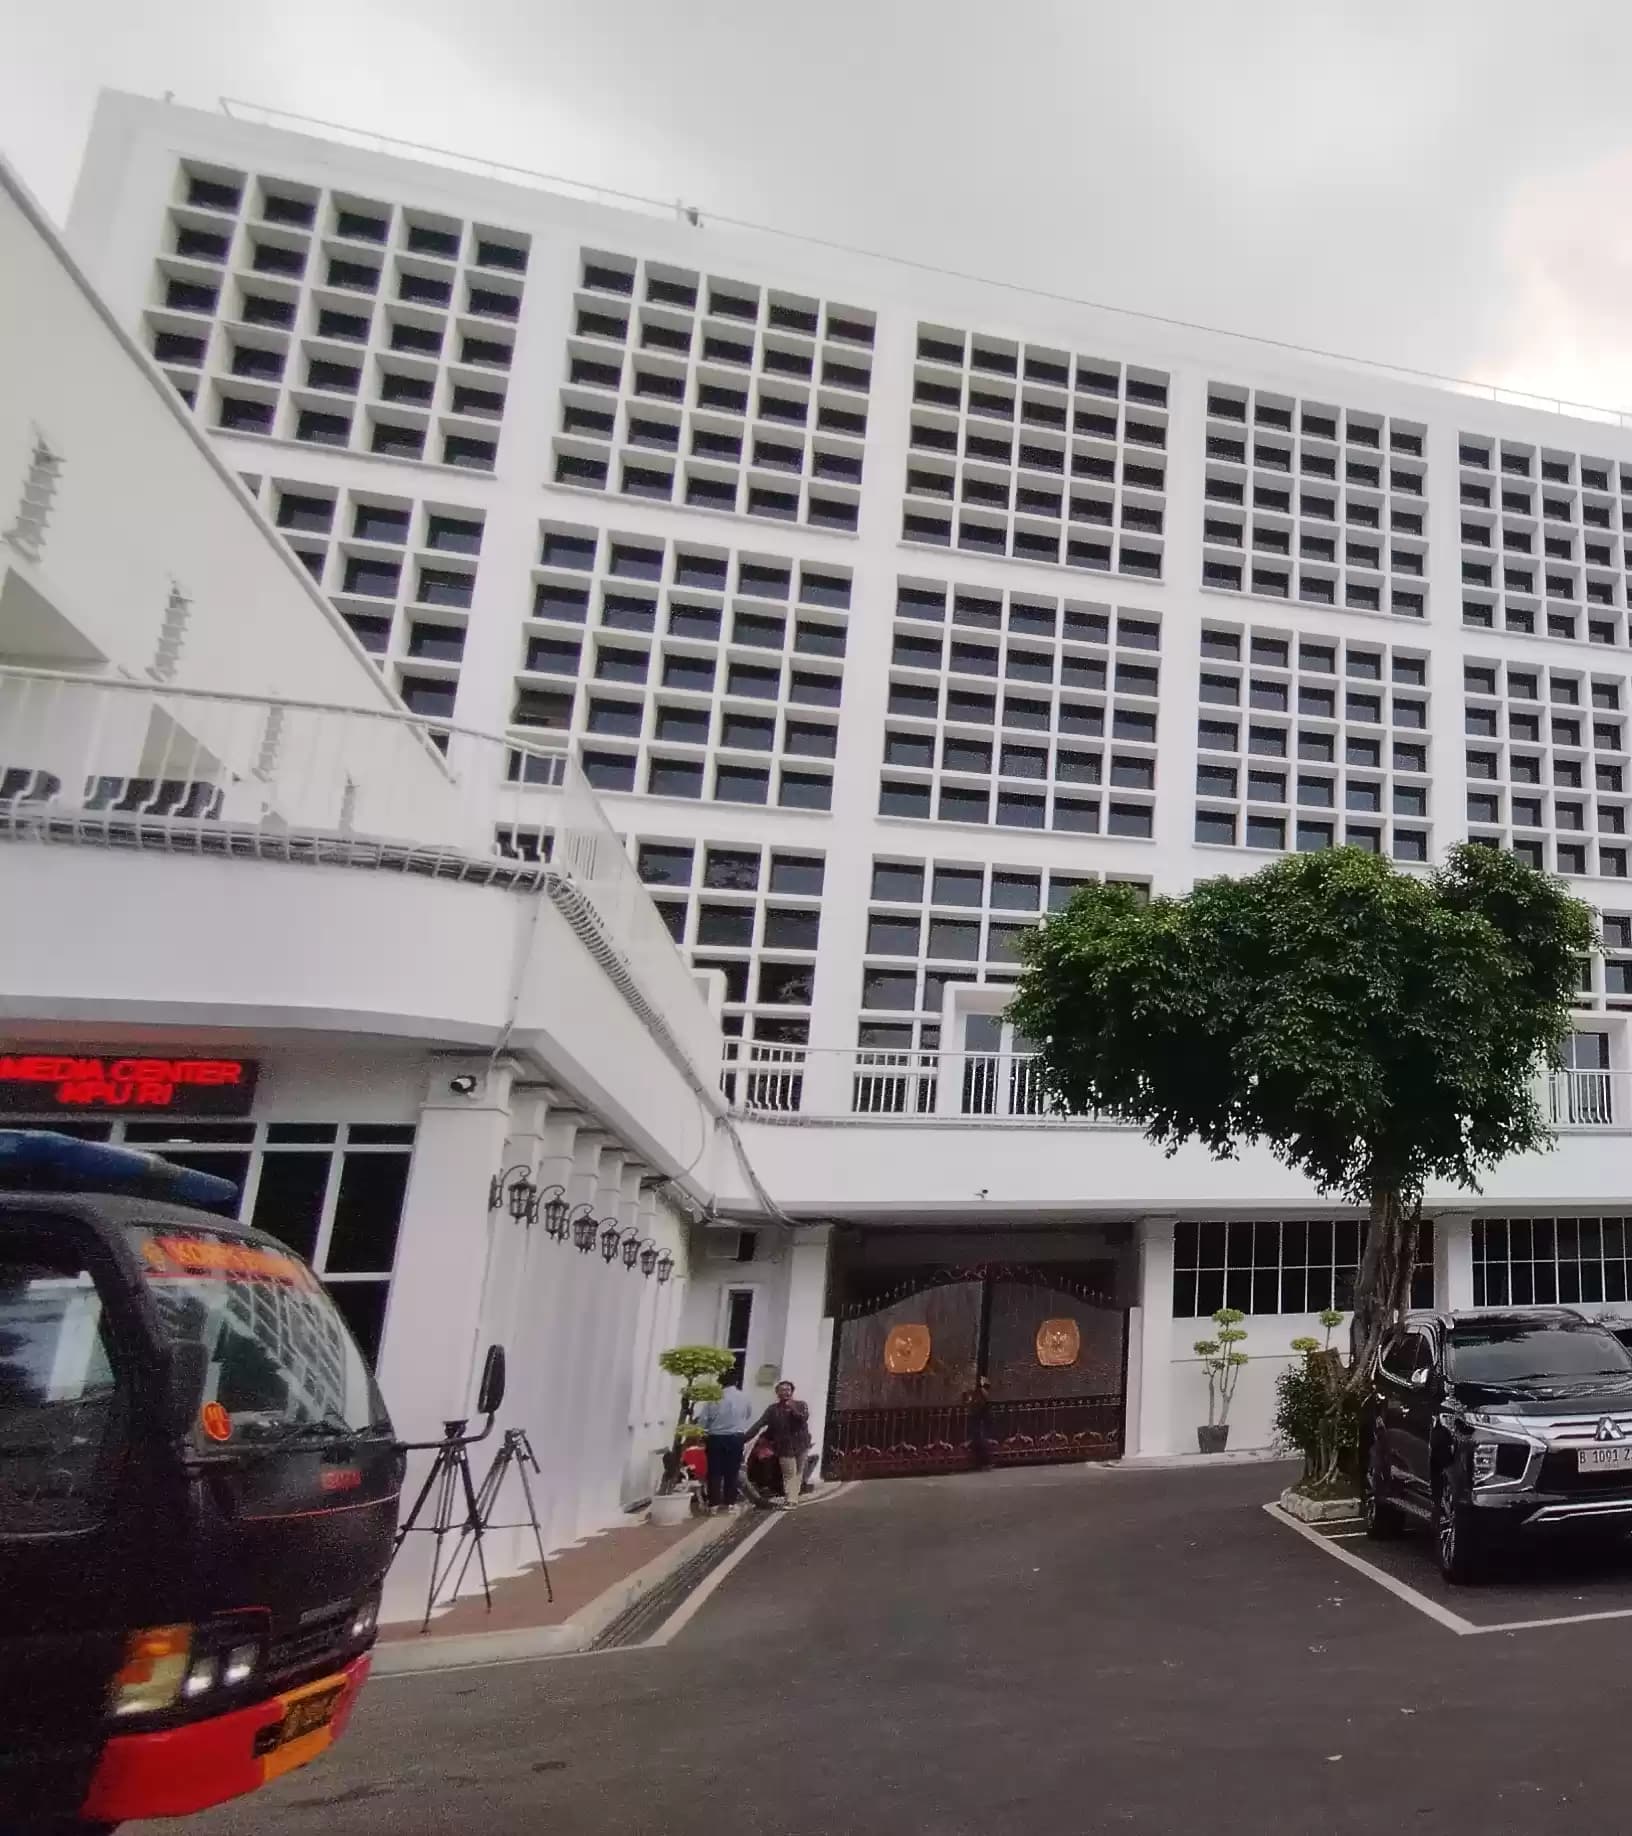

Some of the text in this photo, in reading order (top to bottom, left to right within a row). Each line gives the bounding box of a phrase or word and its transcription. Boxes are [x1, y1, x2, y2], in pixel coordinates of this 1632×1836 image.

[0, 1055, 242, 1084] MEDIA CENTER
[1579, 1451, 1586, 1464] B
[1592, 1448, 1619, 1464] 1091
